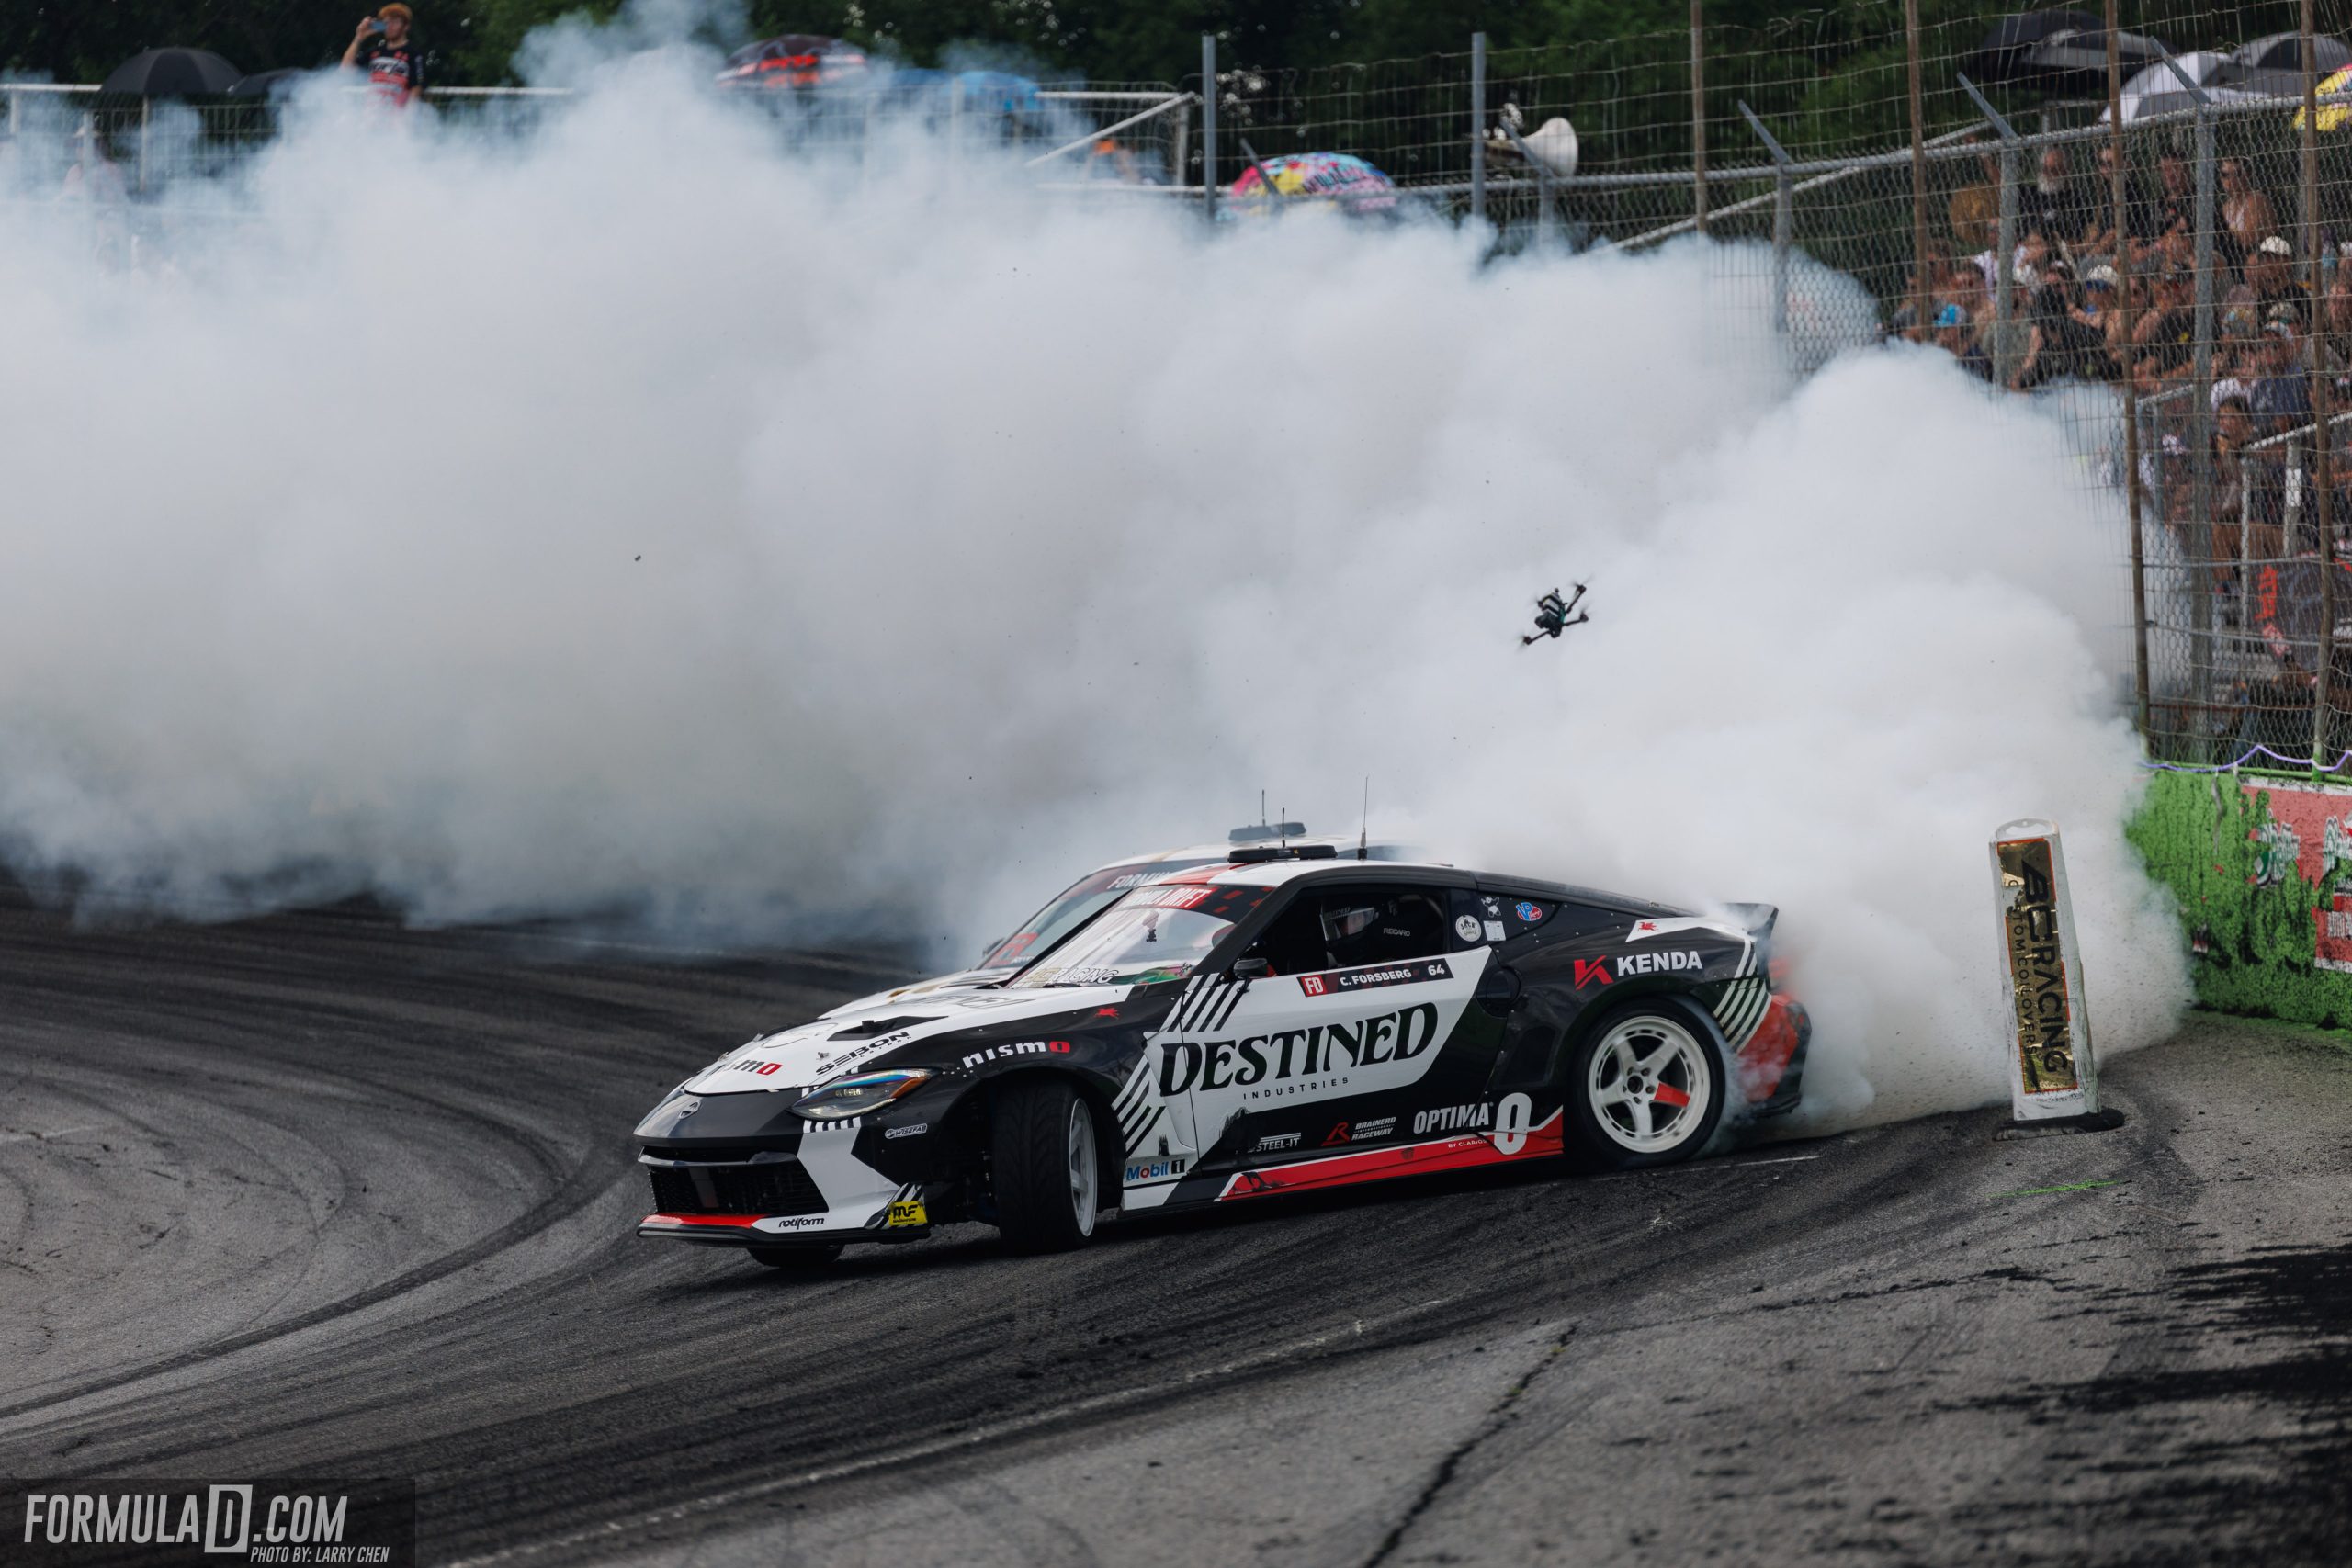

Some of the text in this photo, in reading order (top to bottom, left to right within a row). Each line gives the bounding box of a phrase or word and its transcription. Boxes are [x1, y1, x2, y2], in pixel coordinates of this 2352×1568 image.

[1383, 928, 1411, 937] RECARO
[1617, 951, 1702, 976] KENDA
[1340, 976, 1351, 986] C.
[1351, 969, 1412, 985] FORSBERG
[1428, 964, 1445, 976] 64
[816, 1032, 910, 1075] SEIBON
[963, 1041, 1070, 1068] nismo
[1159, 1002, 1439, 1097] DESTINED
[1243, 1077, 1349, 1100] INDUSTRIES
[1355, 1117, 1396, 1130] BRAINERD
[1413, 1102, 1490, 1134] OPTIMA
[1351, 1127, 1394, 1140] RACEWAY
[1126, 1160, 1170, 1181] Mobil
[778, 1217, 824, 1230] rotiform
